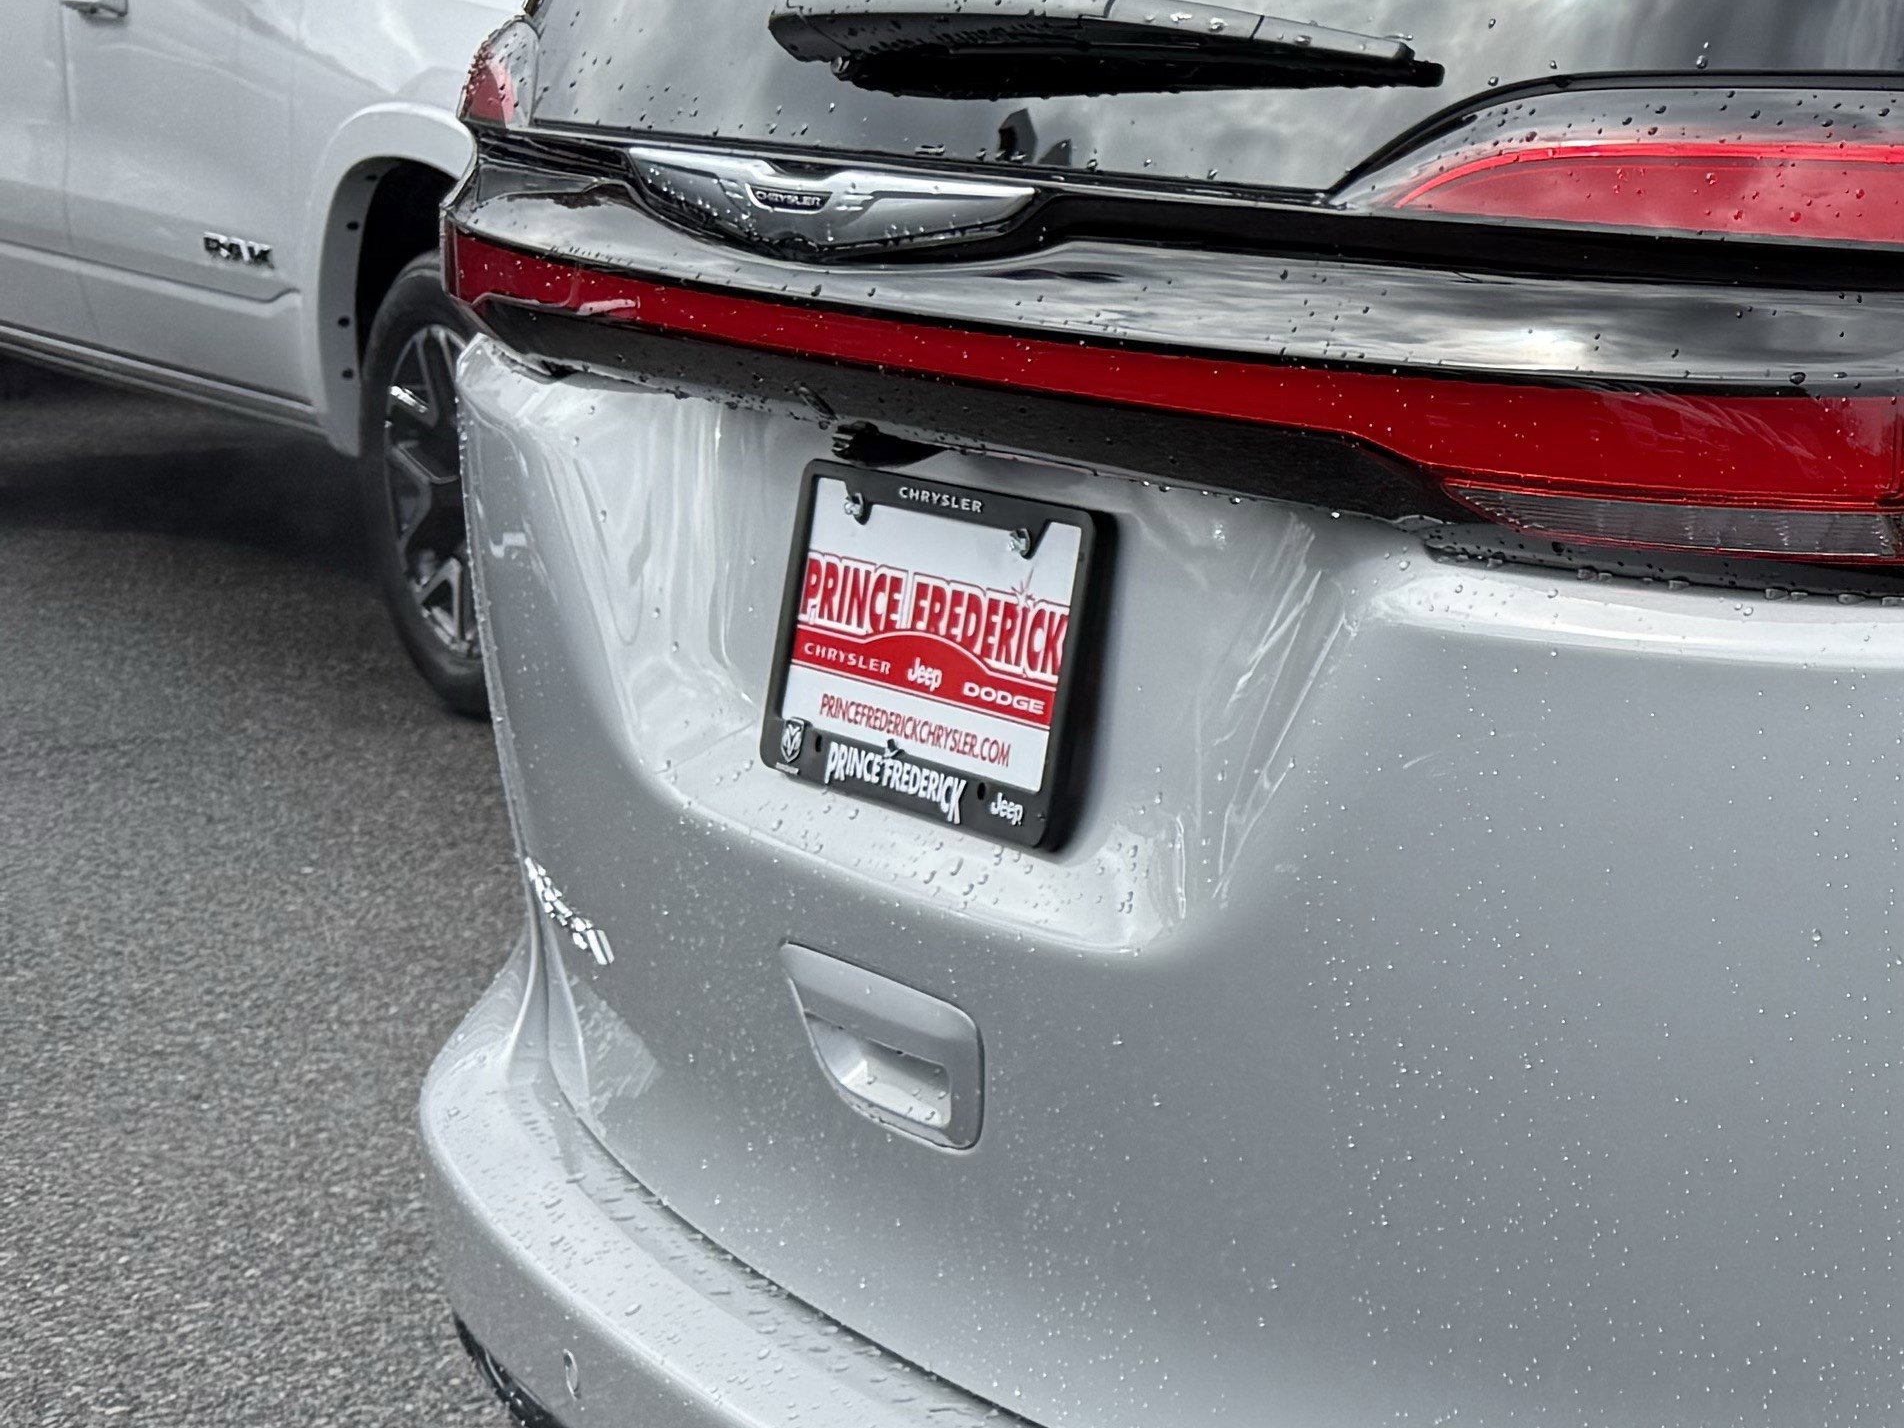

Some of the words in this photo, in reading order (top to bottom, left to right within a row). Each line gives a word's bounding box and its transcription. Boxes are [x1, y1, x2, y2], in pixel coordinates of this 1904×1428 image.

[898, 486, 983, 514] CHRYSLER
[801, 557, 905, 633] PRINCE
[911, 580, 1068, 673] FREDERICK
[803, 641, 891, 675] CHRYSLER
[907, 657, 943, 692] Jeep
[962, 681, 1046, 715] DODGE
[819, 693, 1012, 768] PRINCEFREDERICKCHRYSLER.COM
[823, 741, 883, 785] PRINCE
[882, 757, 968, 825] FREDERICK
[990, 792, 1025, 826] Jeep
